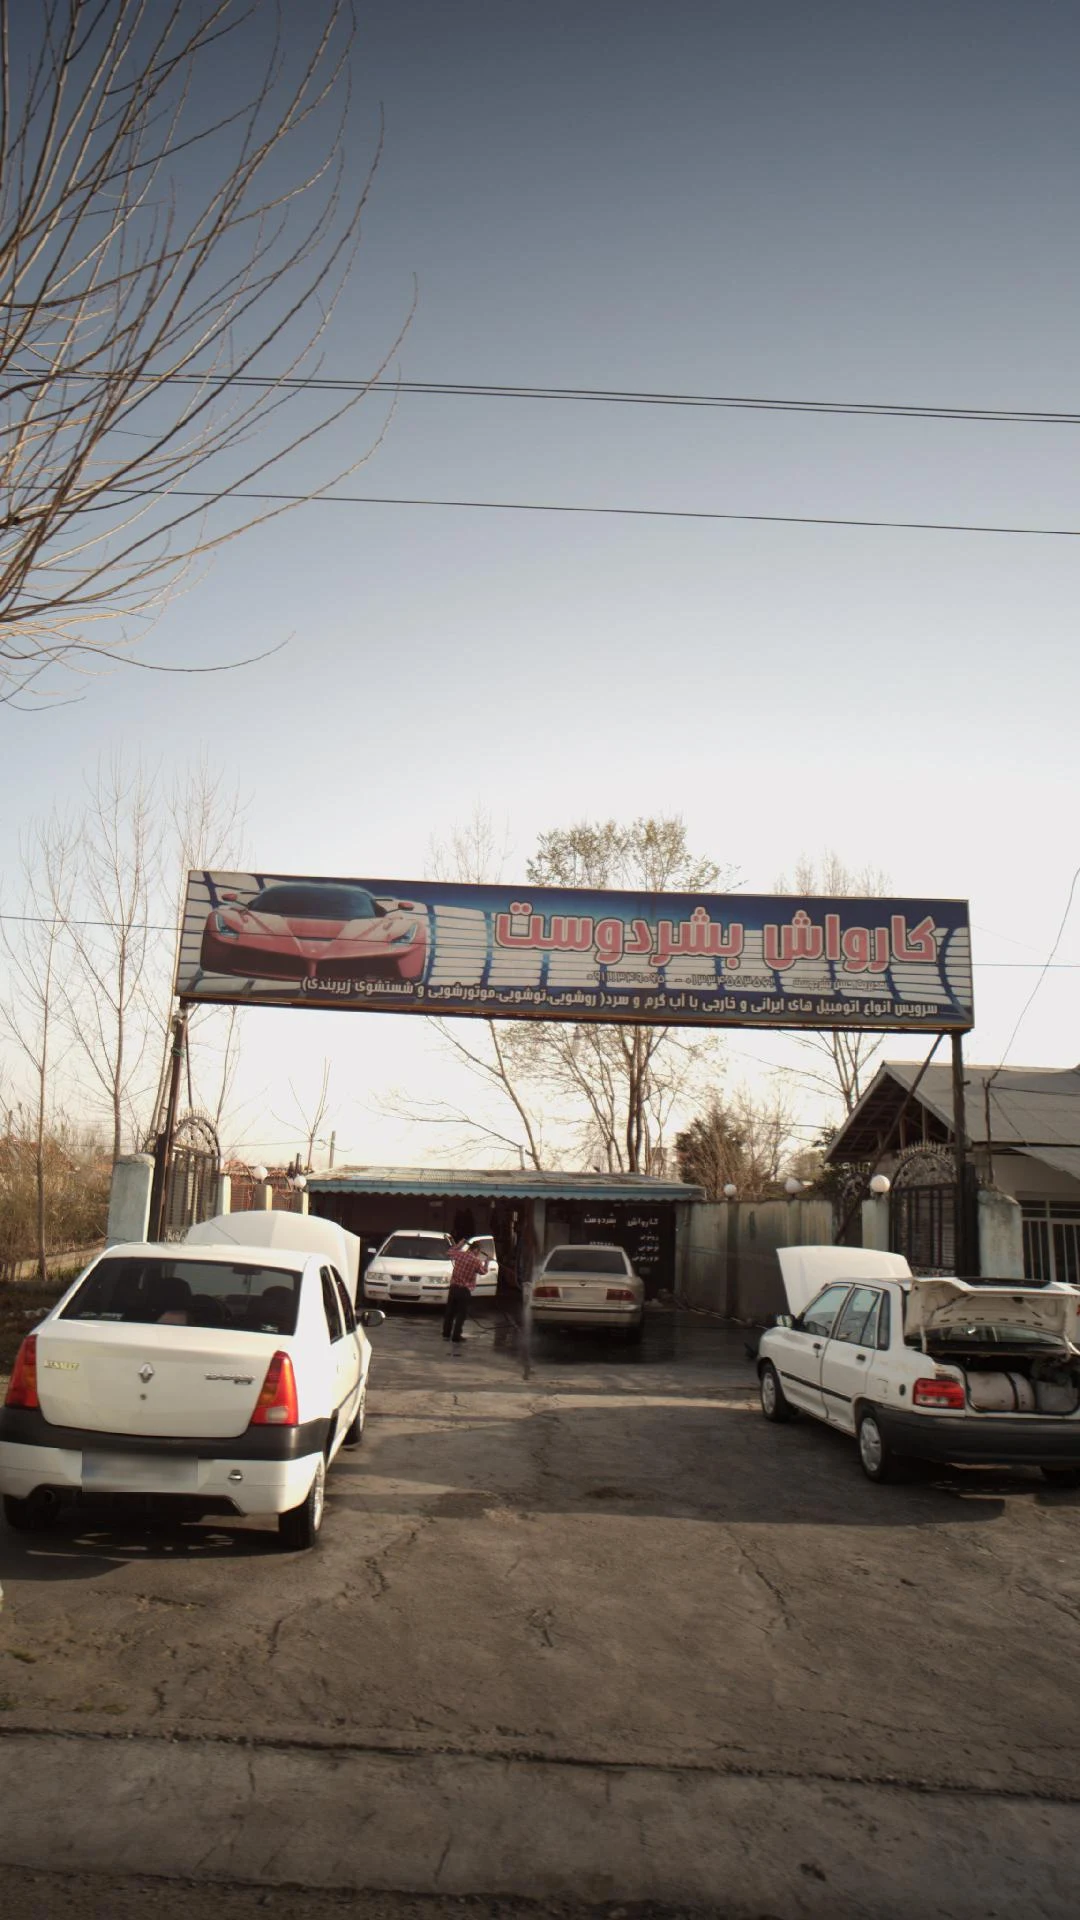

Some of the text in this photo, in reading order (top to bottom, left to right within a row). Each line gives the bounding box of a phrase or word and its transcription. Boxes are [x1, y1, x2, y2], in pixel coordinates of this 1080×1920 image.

[495, 901, 937, 973] کارواش بشردوست
[354, 979, 414, 996] شستشوی
[417, 984, 425, 998] و
[633, 996, 640, 1008] و
[643, 992, 666, 1010] گرم
[669, 994, 685, 1009] آب
[689, 996, 699, 1010] با
[702, 998, 736, 1013] خارجی
[739, 1002, 747, 1013] و
[751, 997, 784, 1012] ایرانی
[788, 998, 812, 1012] های
[816, 999, 860, 1016] اتومبیل
[862, 1000, 891, 1016] انواع
[894, 1002, 938, 1017] سرویس
